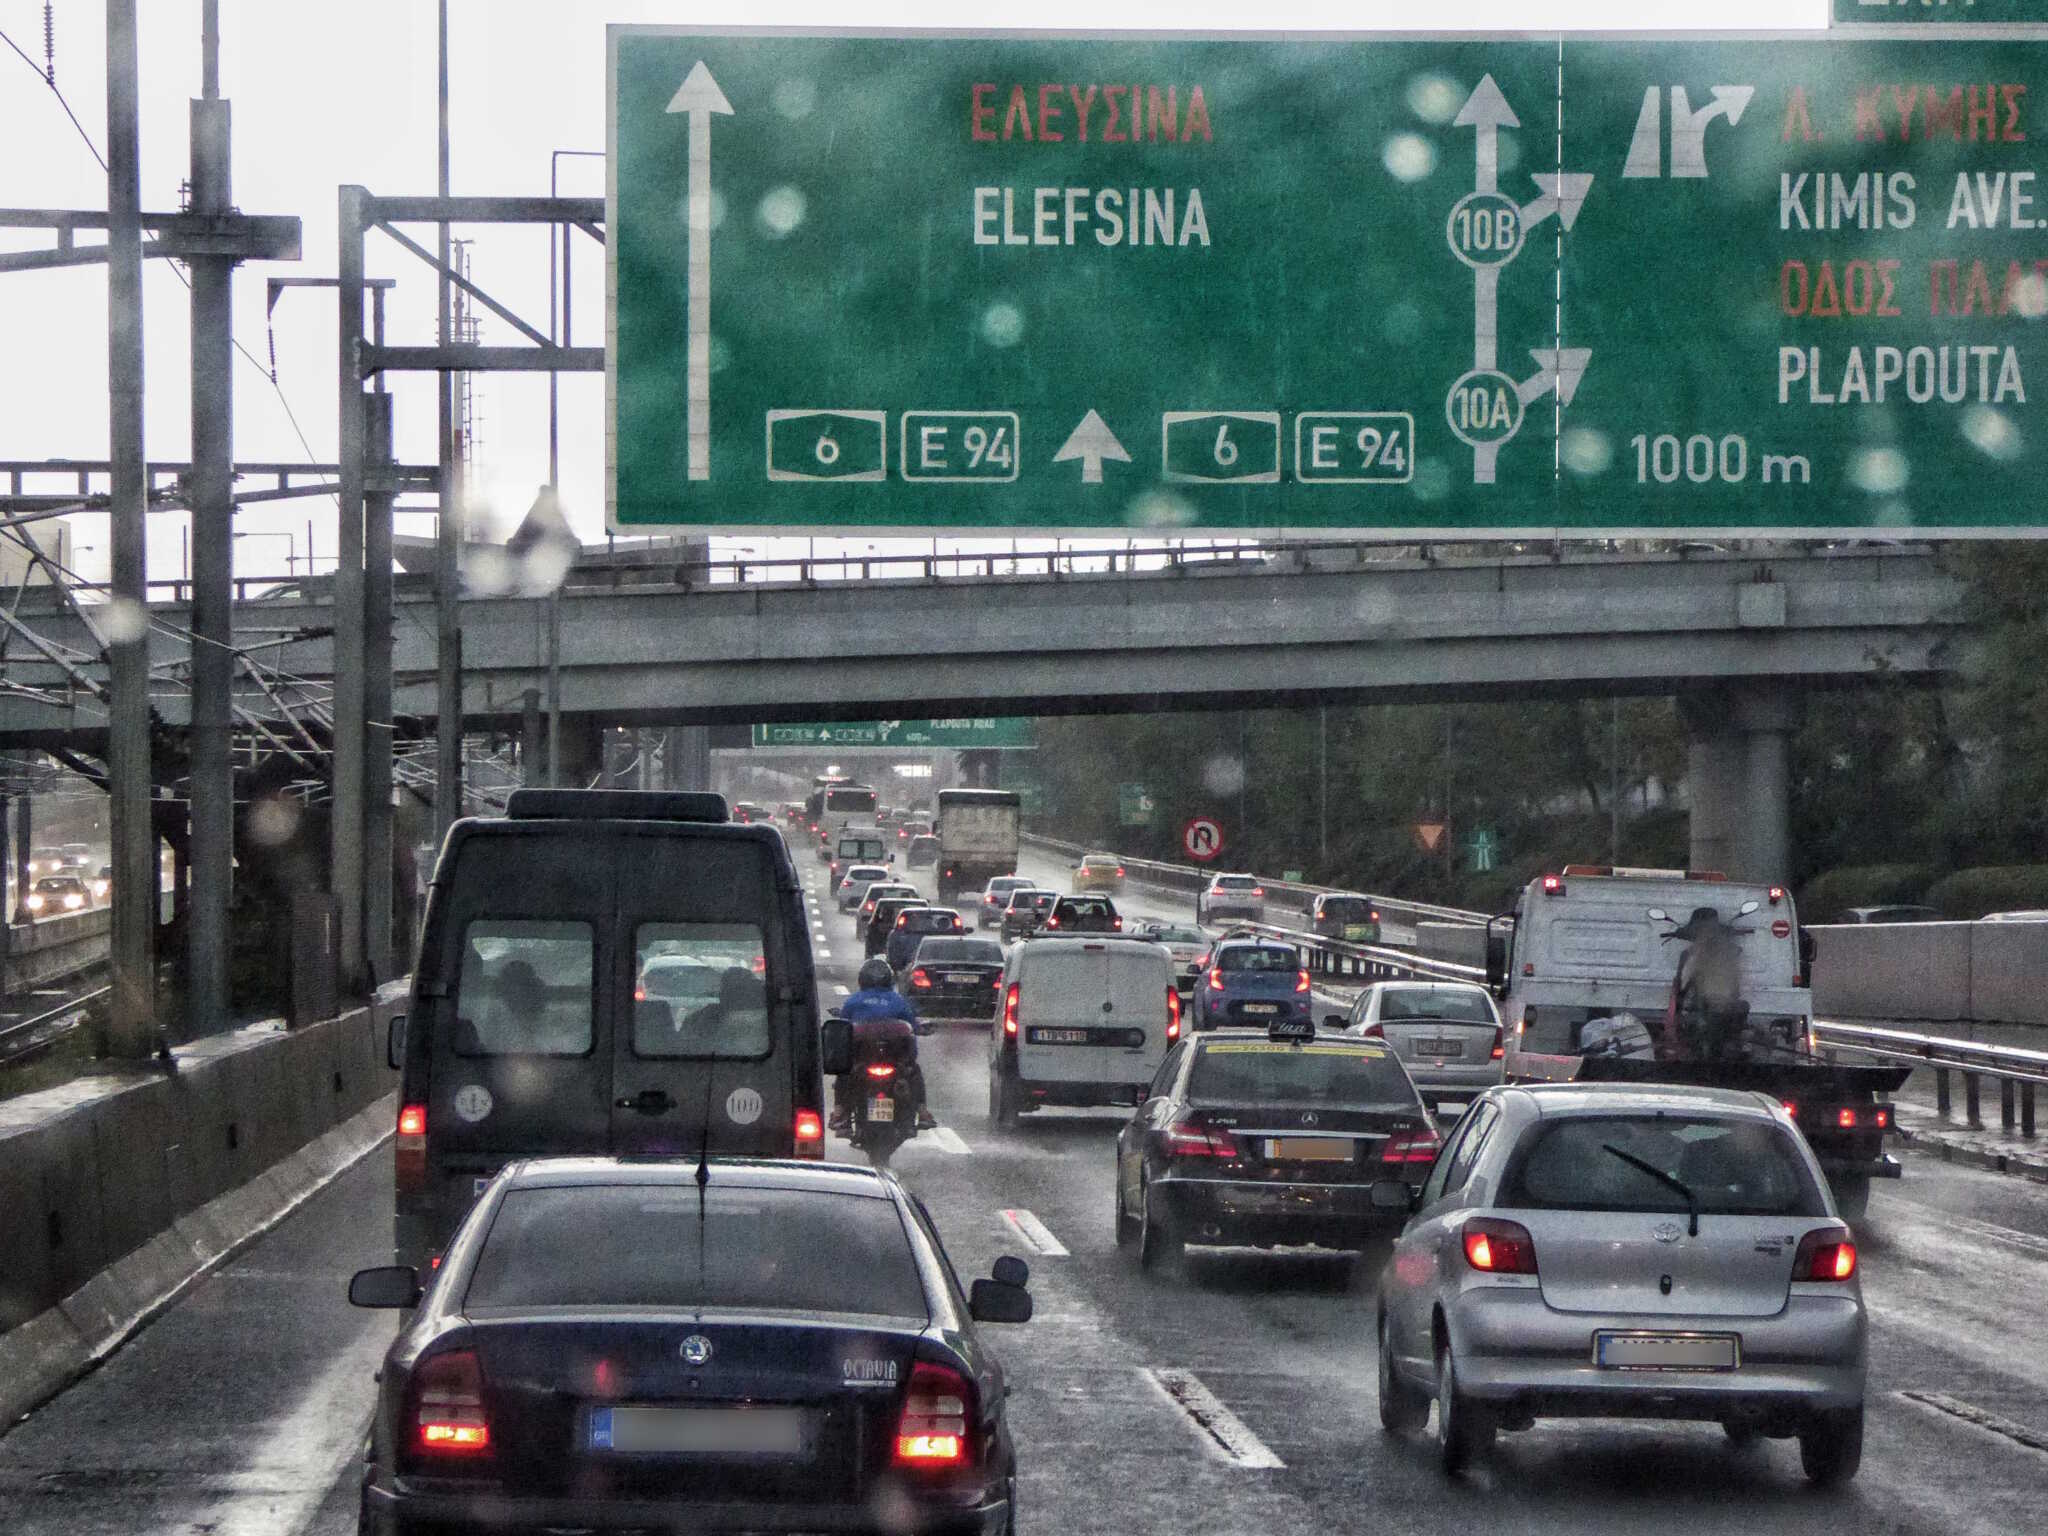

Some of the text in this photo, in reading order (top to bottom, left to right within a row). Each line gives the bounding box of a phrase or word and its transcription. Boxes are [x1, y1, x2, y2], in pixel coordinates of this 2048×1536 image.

[971, 83, 1214, 143] ΕΛΕΥΣΙΝΑ
[1856, 83, 2027, 143] ΚΥΜΗΣ
[973, 186, 1212, 247] ELEFSINA
[1779, 172, 2048, 231] KIMIS AVE.
[1457, 208, 1517, 252] 10B
[1780, 258, 1902, 318] ΟΔΟΣ
[1778, 345, 2027, 404] PLAPOUTA
[1455, 386, 1513, 429] 10A
[920, 426, 1013, 469] E 94
[1213, 423, 1239, 466] 6
[1311, 426, 1407, 471] E 94
[1631, 433, 1811, 484] 1000 m
[842, 1357, 898, 1379] OCTAVIA
